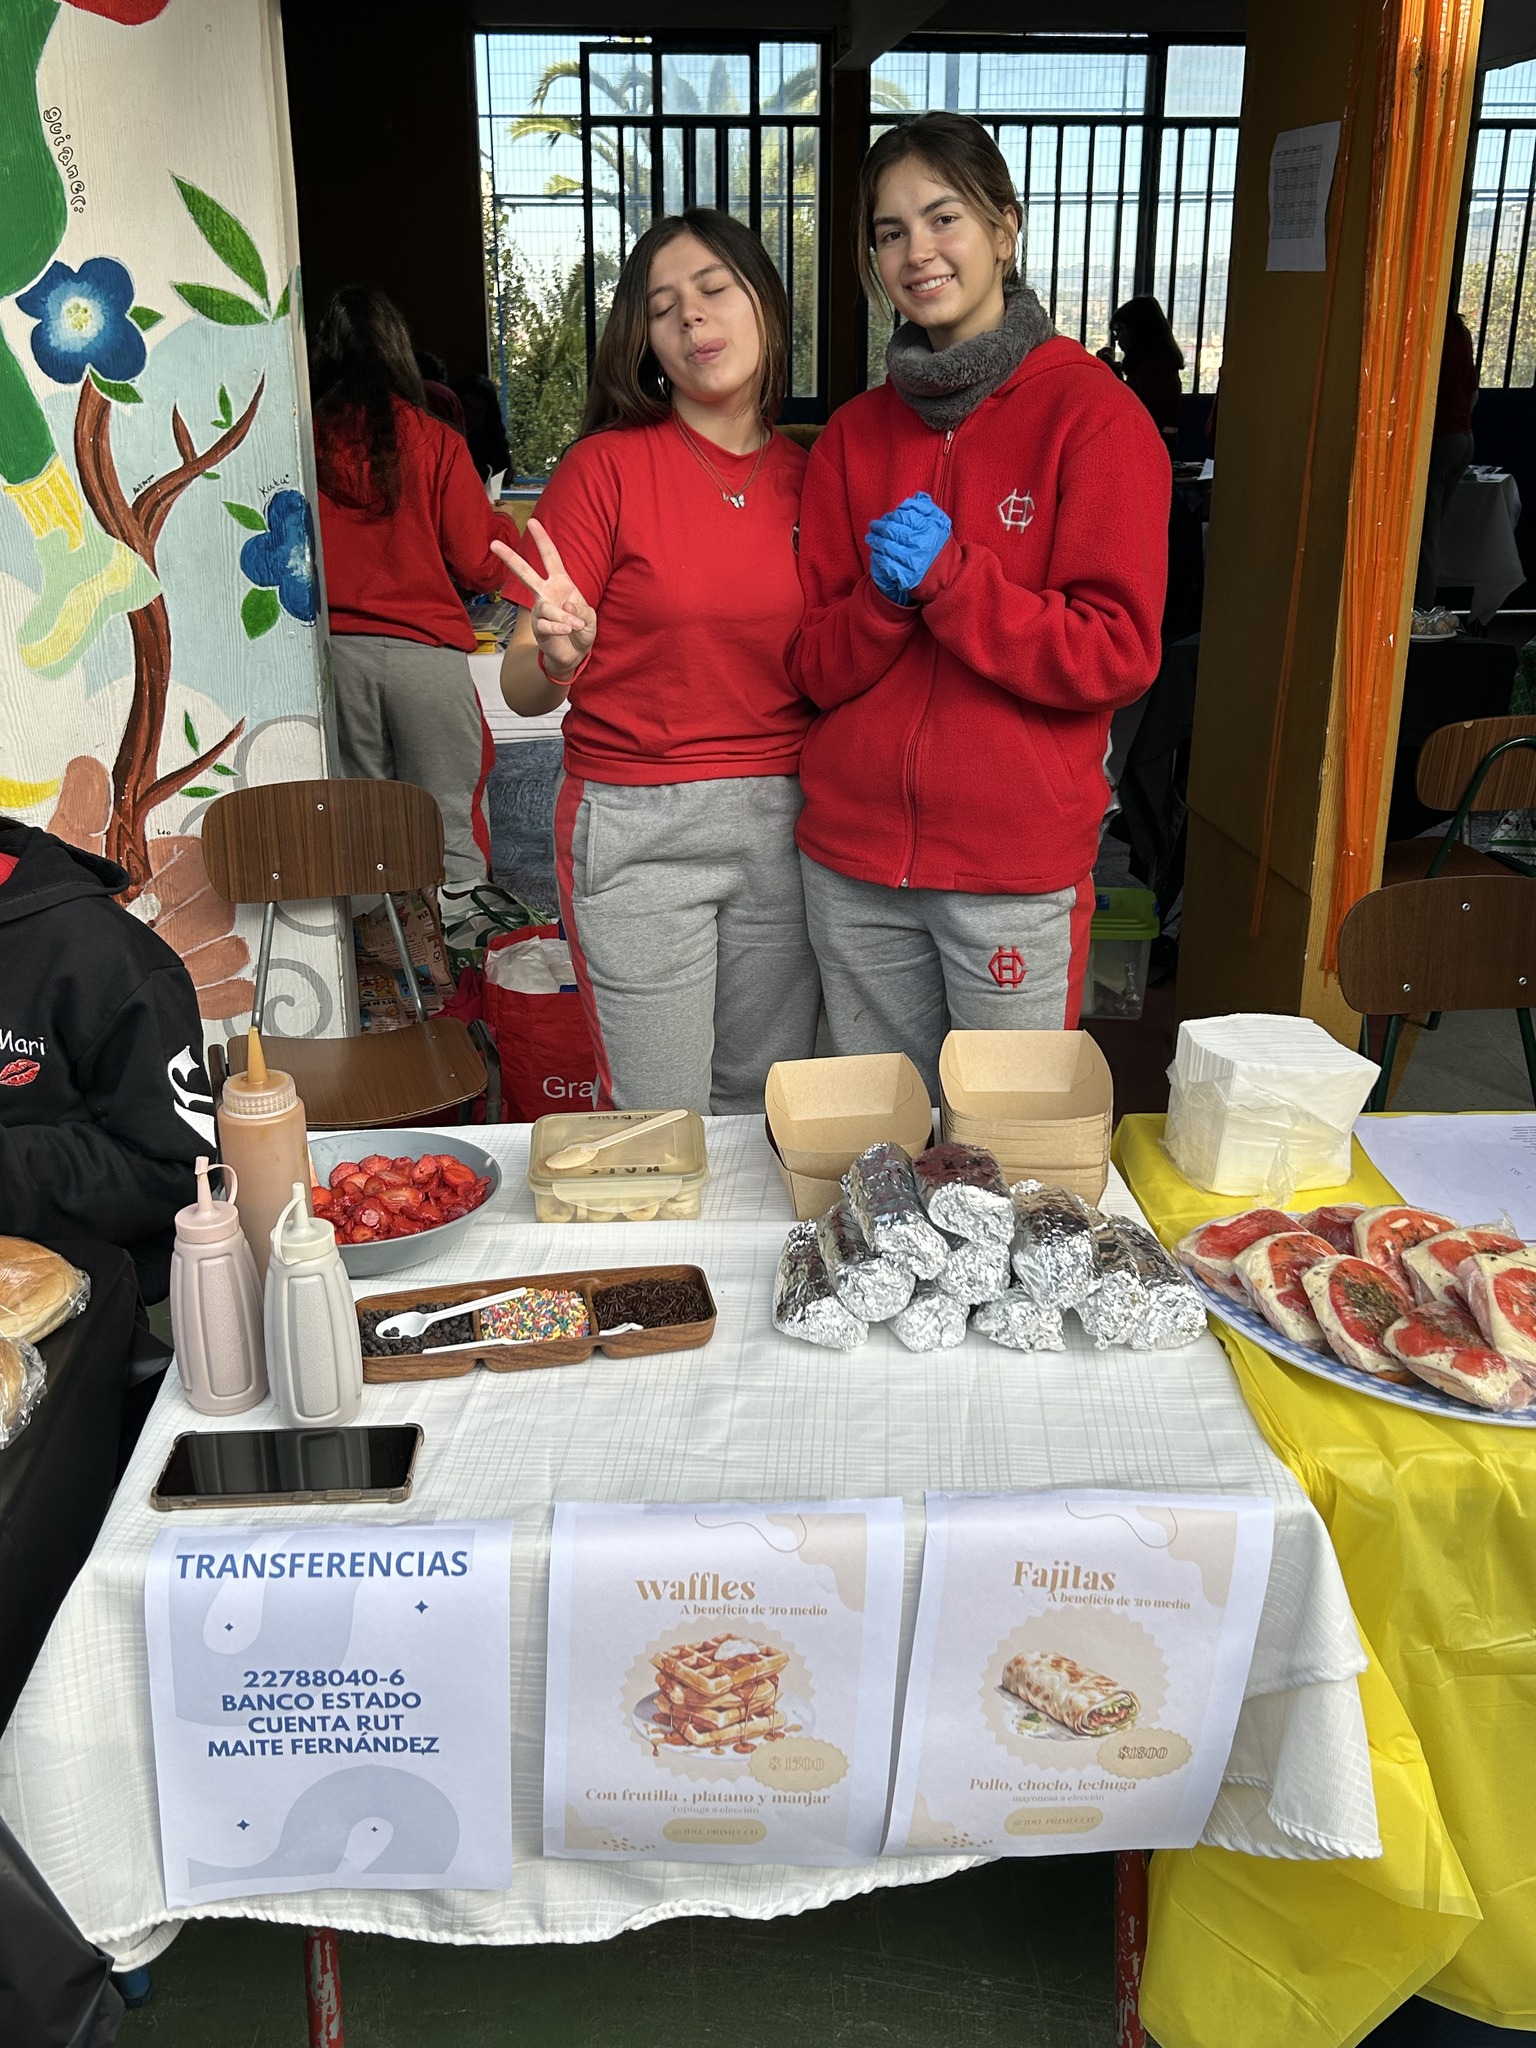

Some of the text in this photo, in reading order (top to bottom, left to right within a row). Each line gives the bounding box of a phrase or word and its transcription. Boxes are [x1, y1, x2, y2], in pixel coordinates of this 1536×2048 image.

[0, 1028, 46, 1056] Mari
[176, 1550, 469, 1580] TRANSFERENCIAS
[635, 1572, 756, 1601] waffles
[1012, 1560, 1116, 1593] Fajitas
[680, 1604, 690, 1616] A
[693, 1603, 749, 1616] beneficio
[751, 1604, 766, 1616] de
[790, 1604, 828, 1616] medio
[1060, 1592, 1115, 1605] beneficio
[1116, 1594, 1131, 1607] de
[1151, 1598, 1191, 1610] medio
[243, 1669, 405, 1688] 22788040-6
[222, 1692, 422, 1712] BANCO ESTADO
[248, 1714, 405, 1734] CUENTA RUT
[208, 1732, 440, 1757] MAITE FERNÁNDEZ
[969, 1778, 1137, 1793] Pollo, choclo, lechuga
[585, 1788, 617, 1801] Con
[622, 1788, 678, 1802] frutilla
[692, 1789, 754, 1804] platano
[757, 1793, 767, 1806] y
[772, 1792, 830, 1807] manjar
